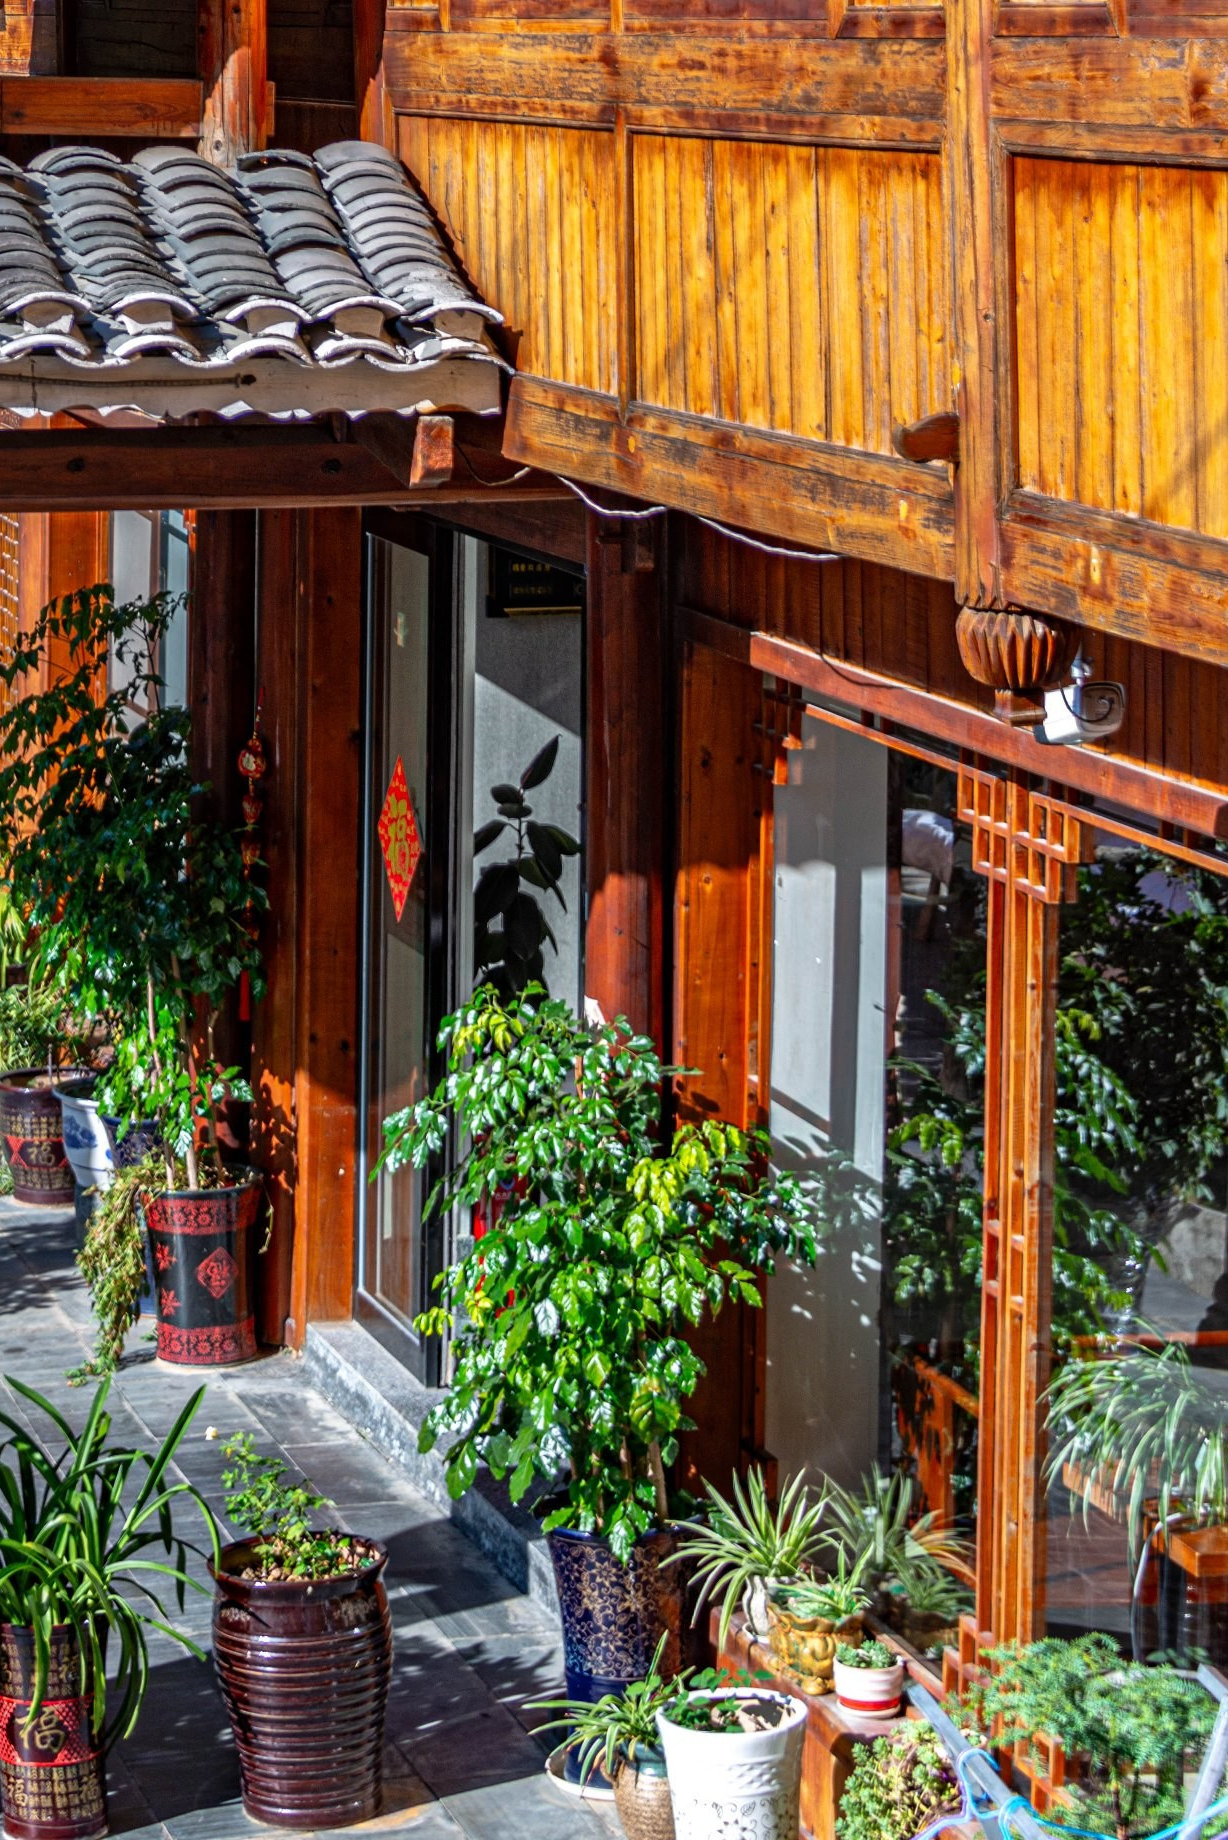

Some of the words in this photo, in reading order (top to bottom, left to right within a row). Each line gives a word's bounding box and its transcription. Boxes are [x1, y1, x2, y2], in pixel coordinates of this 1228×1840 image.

[387, 793, 411, 881] 福
[27, 1141, 55, 1166] 福
[15, 1704, 66, 1753] 福
[7, 1775, 28, 1807] 福
